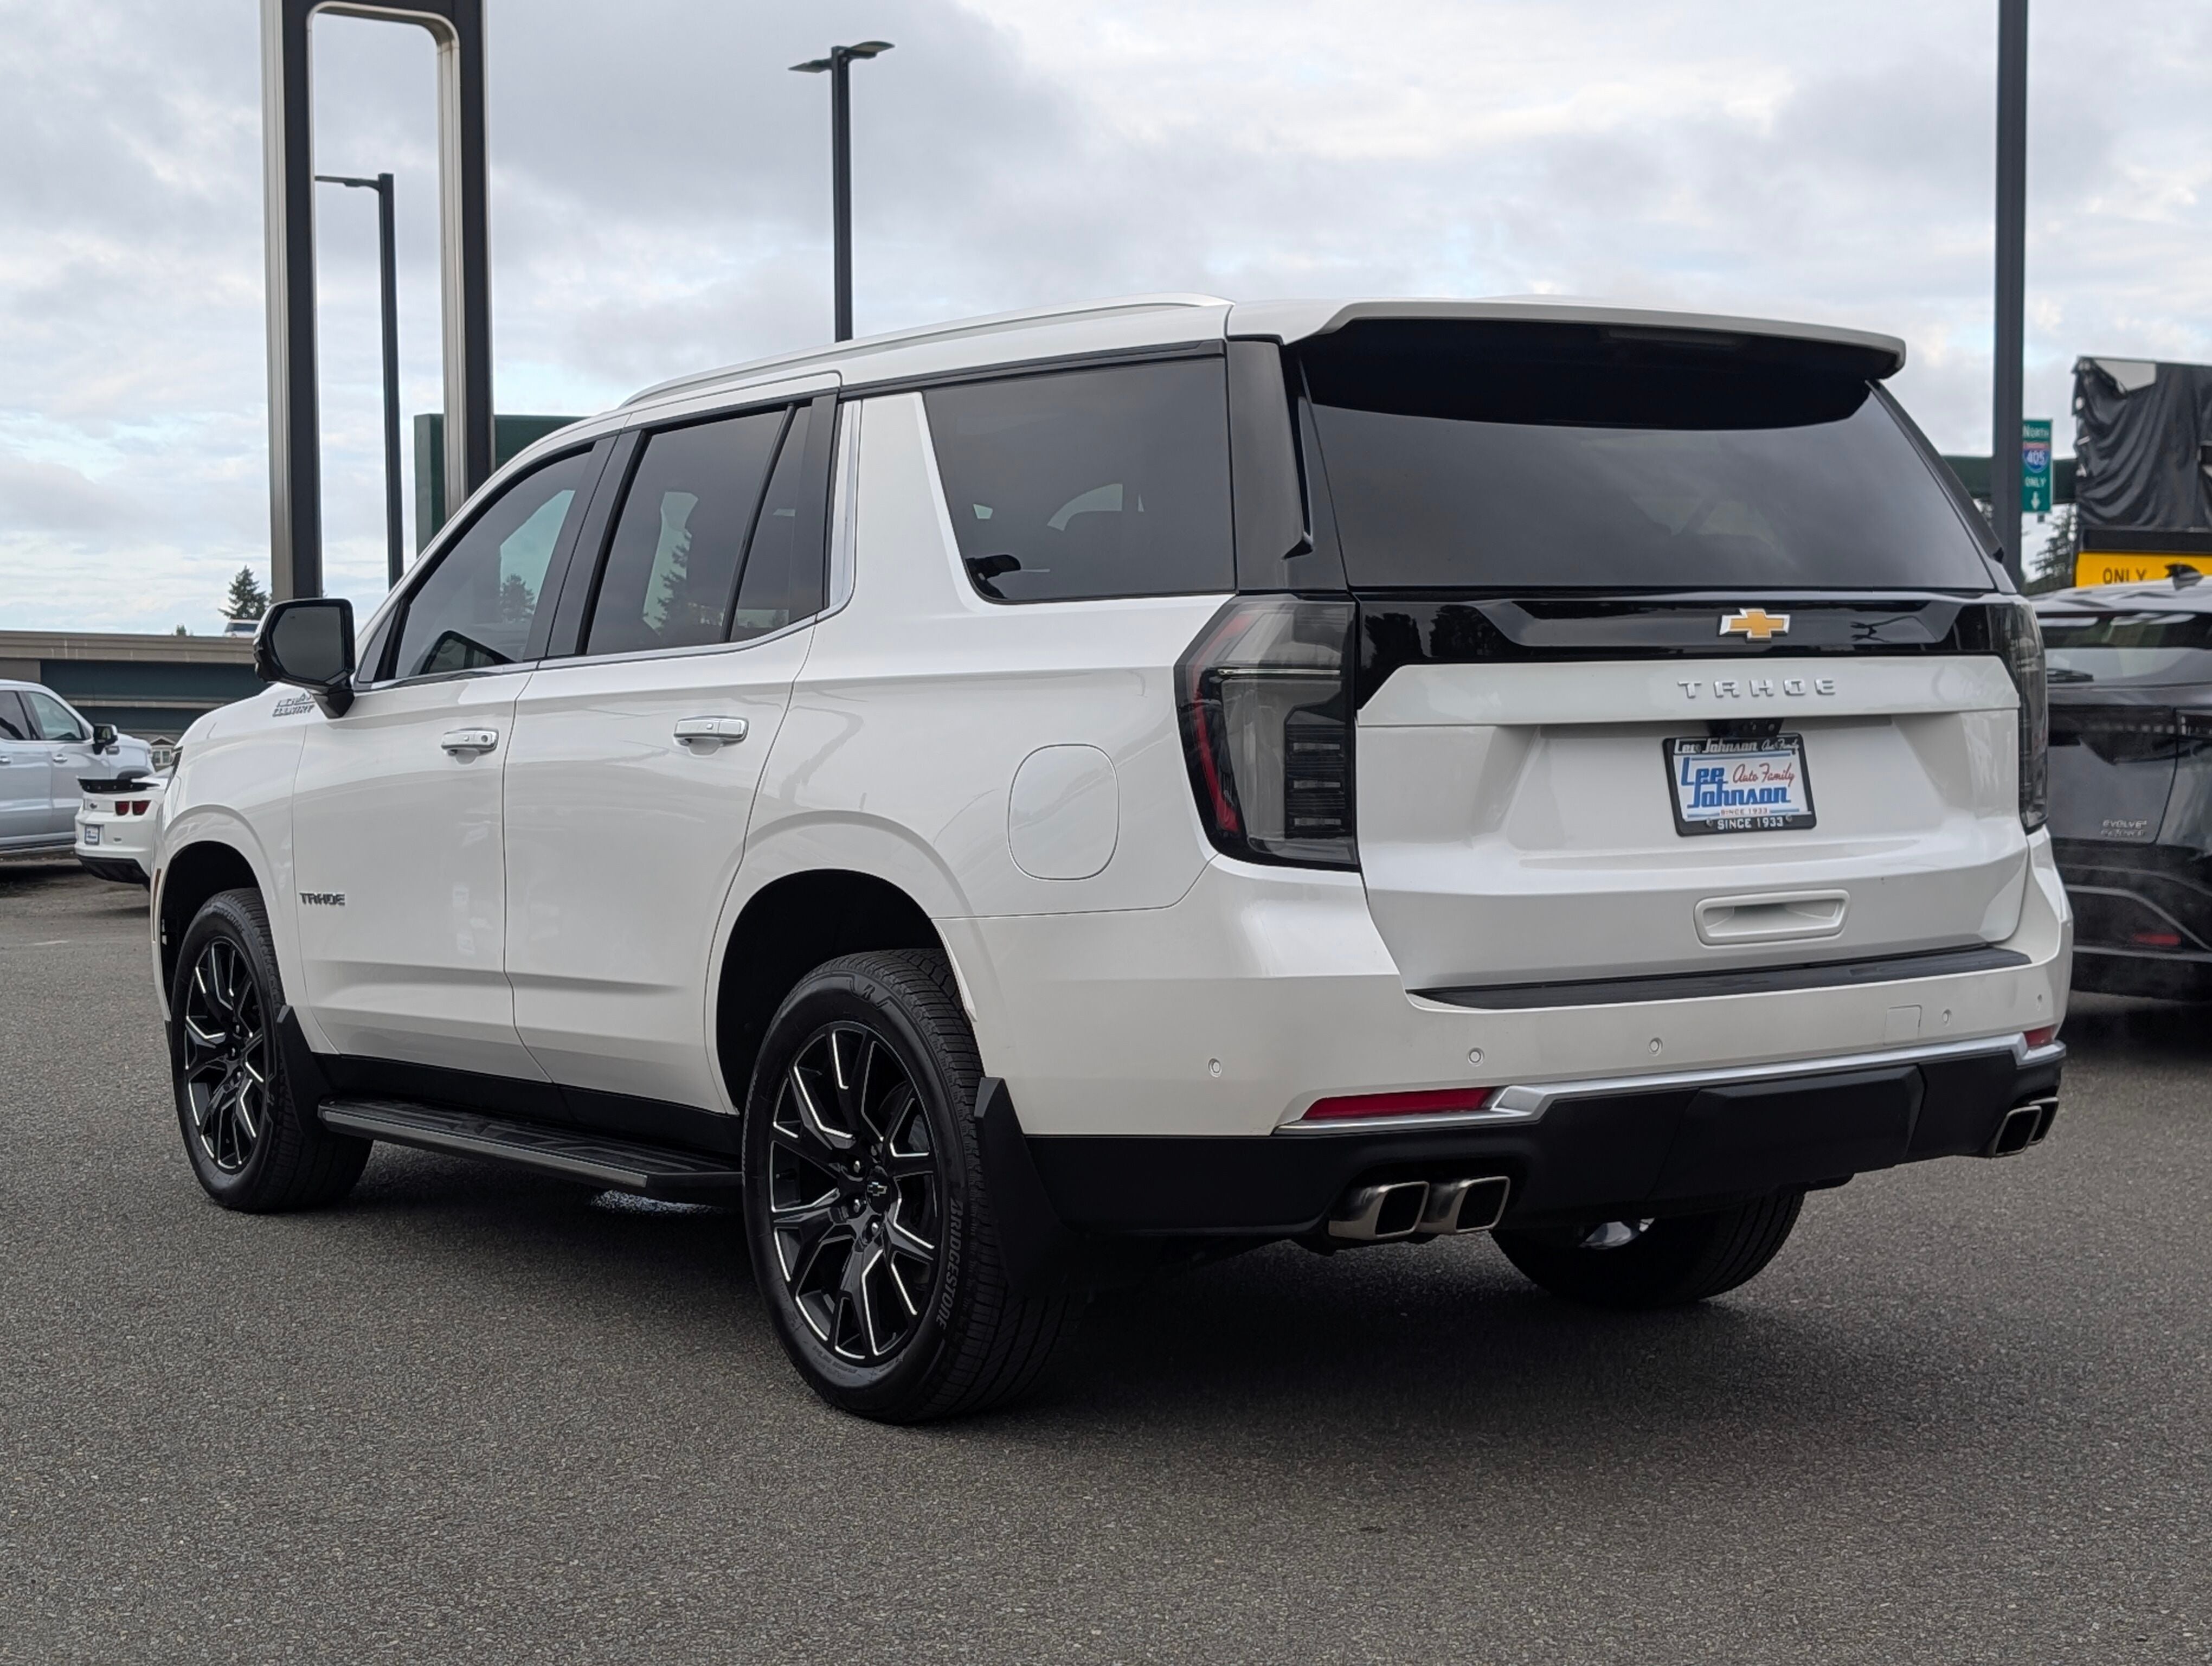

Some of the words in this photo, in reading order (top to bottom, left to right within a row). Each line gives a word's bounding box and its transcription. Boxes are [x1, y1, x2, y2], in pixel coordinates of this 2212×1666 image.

[2027, 450, 2045, 465] 405
[2025, 477, 2047, 488] ONLY
[1677, 678, 1836, 699] TAHOE
[1702, 738, 1758, 753] Johnson
[1681, 757, 1728, 786] Lee
[1733, 763, 1758, 784] Auto
[1759, 762, 1795, 787] Family
[1687, 784, 1791, 809] Johnson
[1717, 818, 1752, 830] SINCE
[1757, 817, 1784, 828] 1933
[299, 891, 346, 906] TAHOE
[936, 1197, 964, 1330] BRIDGESTONE
